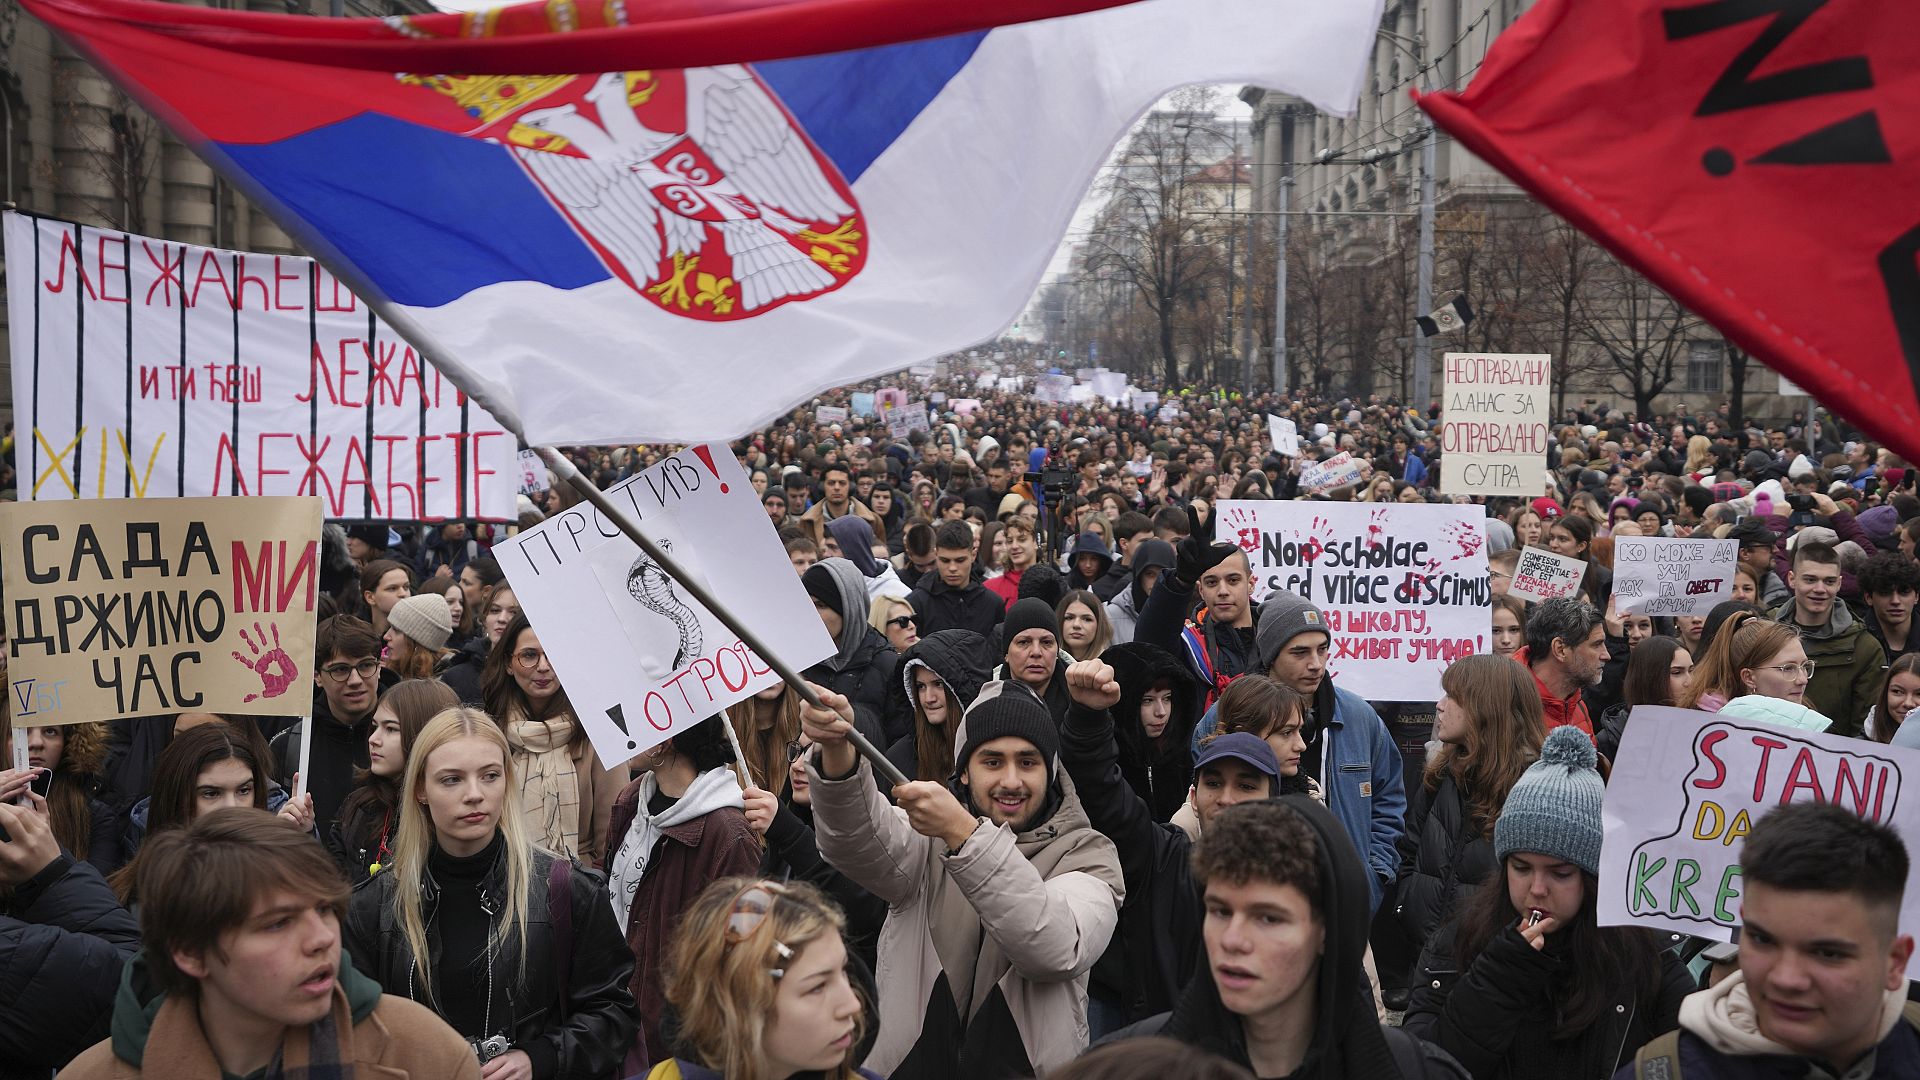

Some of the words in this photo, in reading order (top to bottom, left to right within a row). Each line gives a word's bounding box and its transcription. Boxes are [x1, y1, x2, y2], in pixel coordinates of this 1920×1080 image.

[295, 338, 469, 408] ЛЕЖА
[1446, 358, 1550, 386] НЕОПРАВДАНИ
[1450, 392, 1506, 413] ДАНАС
[1512, 394, 1535, 415] ЗА
[1443, 422, 1548, 454] ОПРАВДАНО
[32, 427, 166, 501] XIV
[212, 431, 507, 521] ЛЕЖАЋЕТЕ
[1463, 463, 1521, 488] СУТРА
[1524, 551, 1561, 567] CONFESSIO
[1620, 543, 1647, 561] КО
[1654, 543, 1704, 562] МОЖЕ
[1710, 543, 1734, 563] ДА
[21, 521, 221, 585] САДА
[231, 540, 318, 613] МИ
[1520, 566, 1536, 577] VOX
[1539, 572, 1553, 582] EST
[1522, 559, 1571, 579] CONSCIENTIAE
[1657, 564, 1690, 581] УЧИ
[1323, 571, 1390, 606] vitae
[1514, 581, 1534, 593] GLAS
[1517, 573, 1557, 592] PRIZNANJE
[1614, 580, 1644, 598] ДОК
[1659, 582, 1676, 598] ГА
[1645, 598, 1697, 614] МУЧИ?
[10, 589, 226, 658] ДРЖИМО
[92, 651, 204, 714] ЧАС
[1692, 730, 1889, 824] STANI
[1632, 852, 1743, 922] KRE
